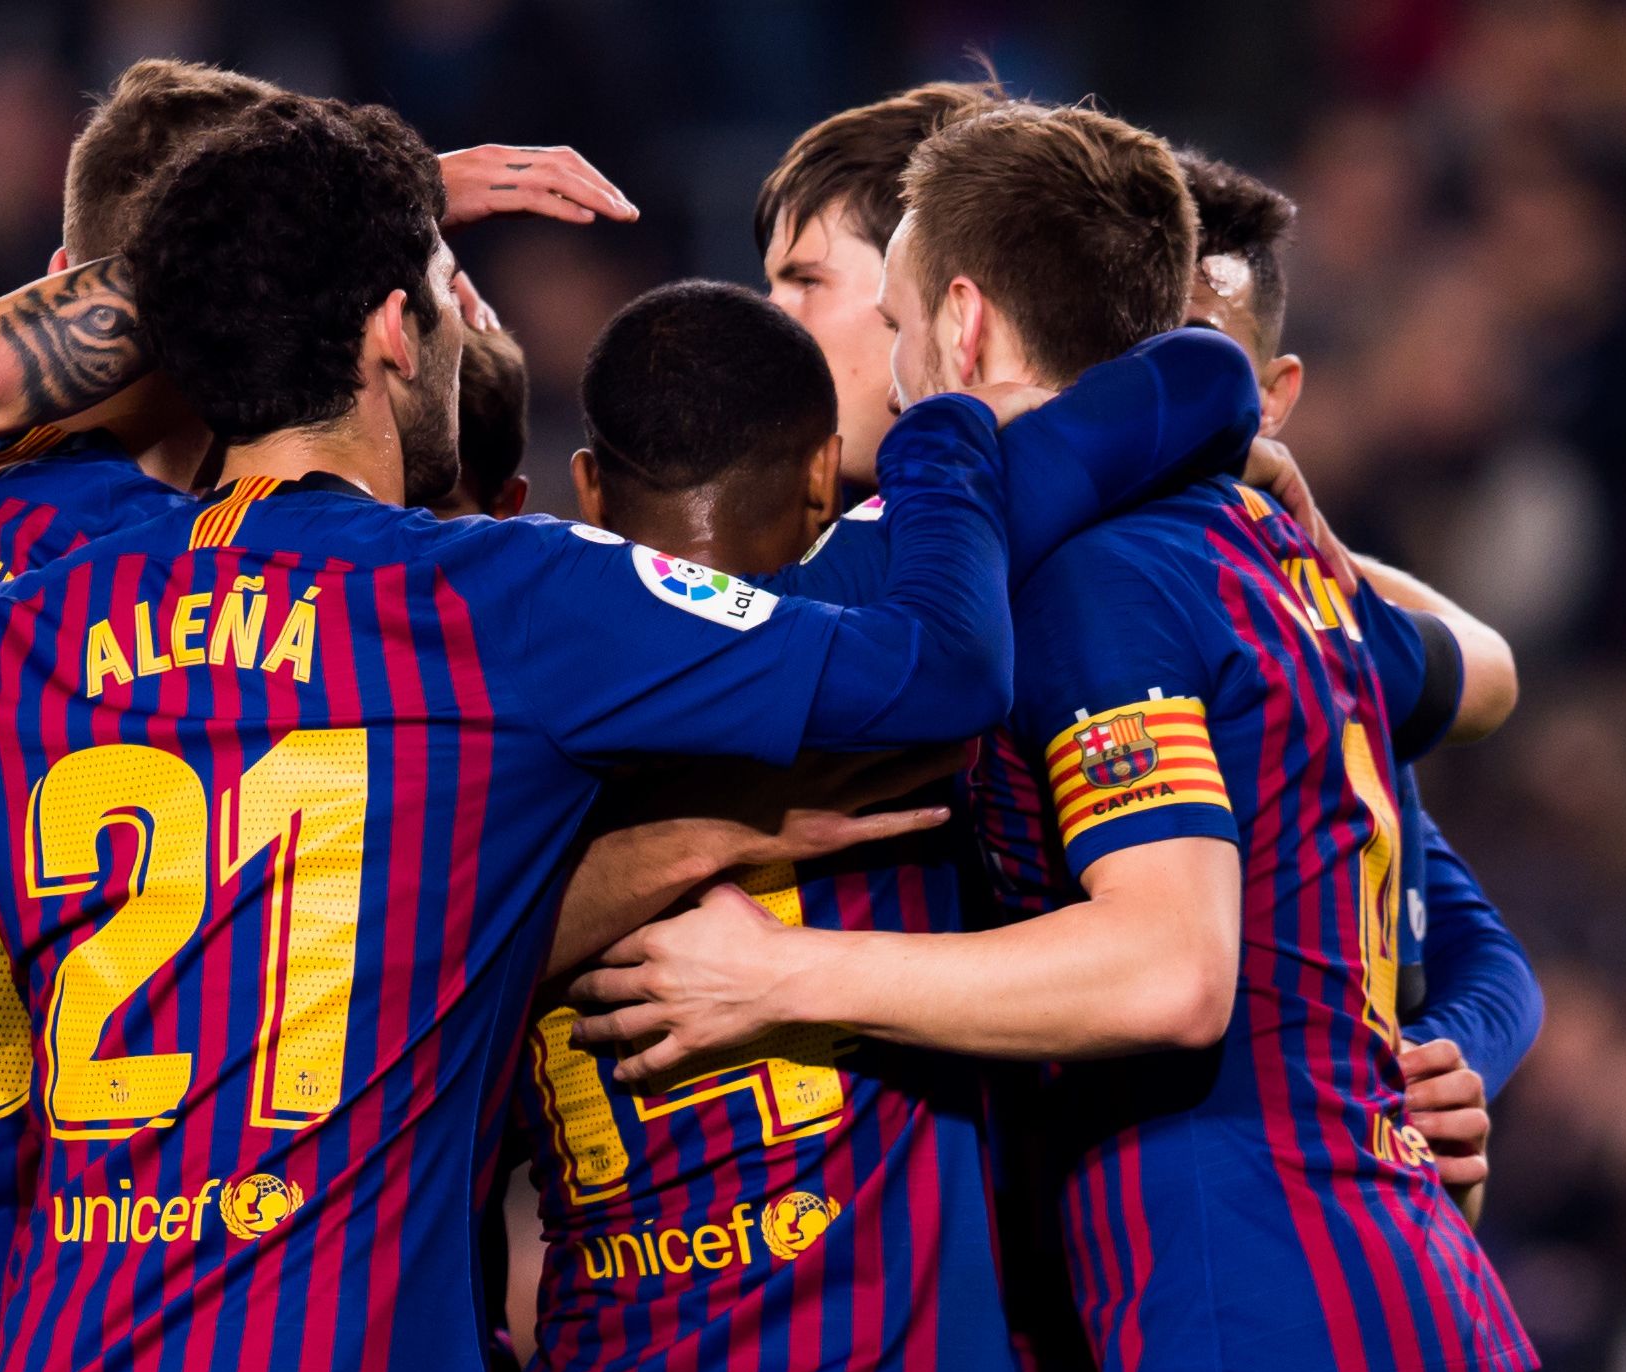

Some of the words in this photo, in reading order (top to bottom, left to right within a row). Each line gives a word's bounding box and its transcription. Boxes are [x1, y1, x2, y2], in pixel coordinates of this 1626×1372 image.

[87, 575, 323, 699] ALEÑÁ
[1092, 781, 1175, 816] CAPITA
[25, 727, 369, 1141] 21
[54, 1179, 220, 1243] unicef
[576, 1203, 754, 1280] unicef
